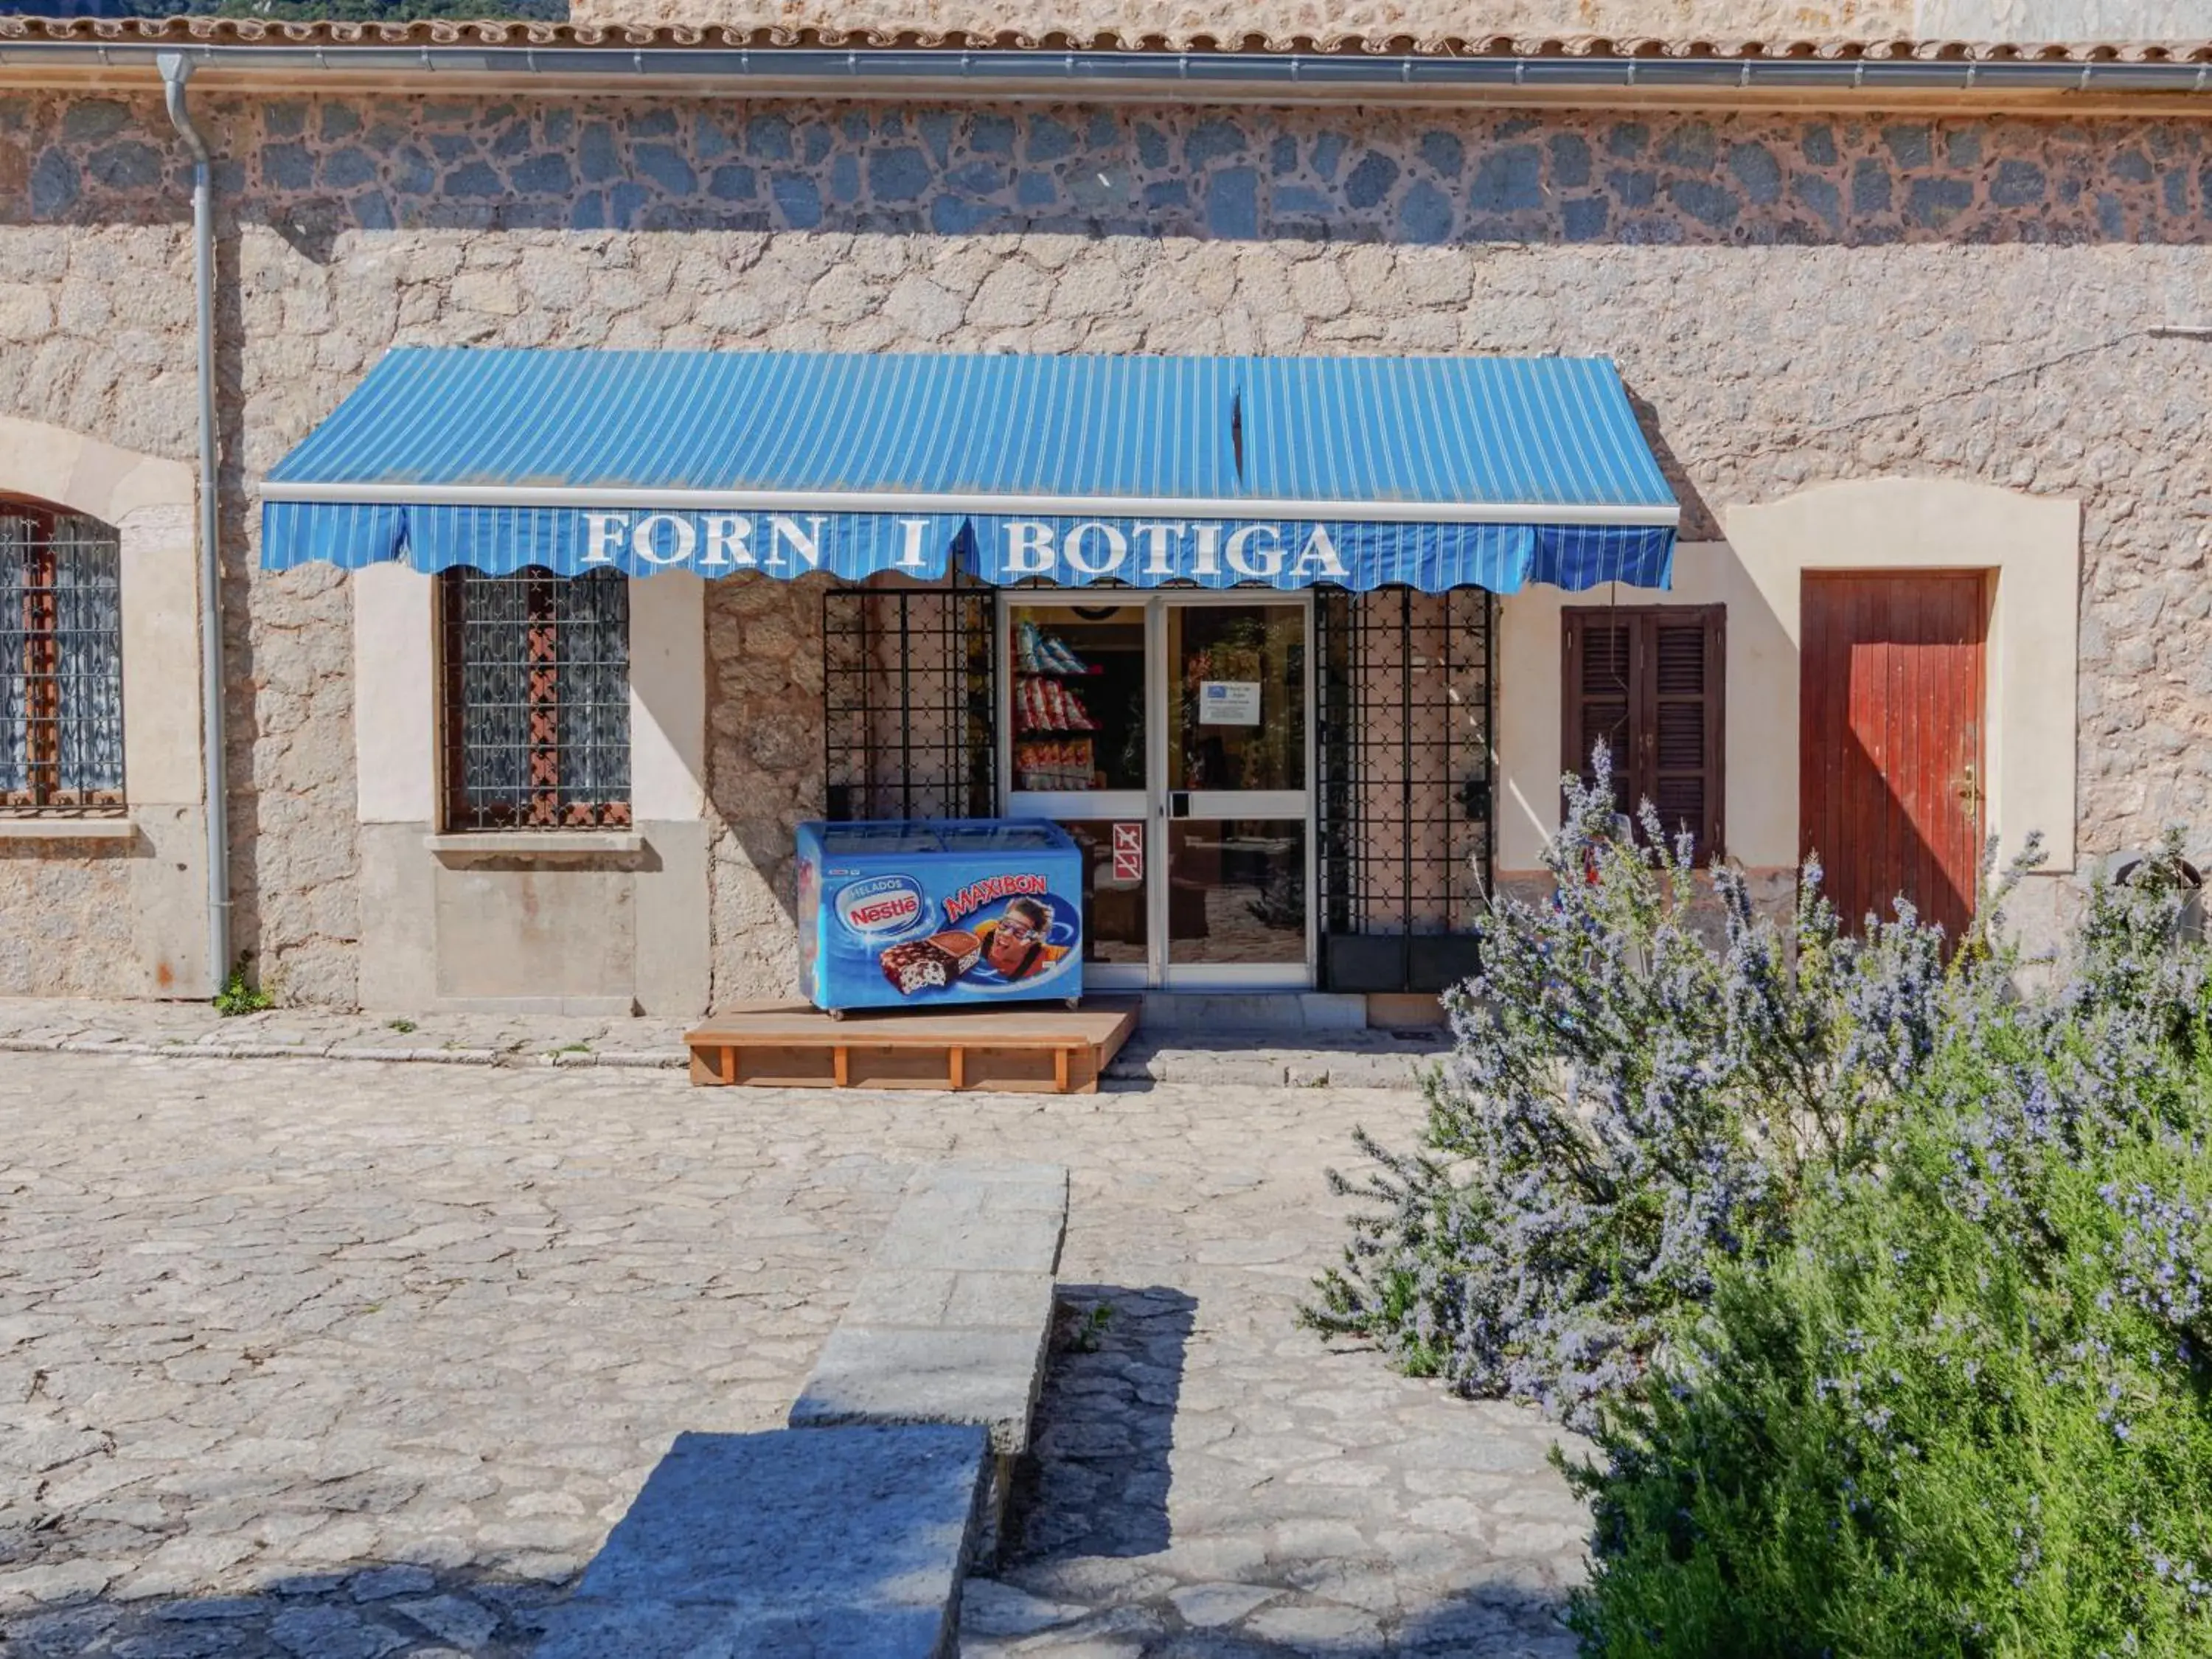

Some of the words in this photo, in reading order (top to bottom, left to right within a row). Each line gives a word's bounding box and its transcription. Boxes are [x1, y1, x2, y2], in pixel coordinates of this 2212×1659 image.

[580, 512, 828, 567] FORN
[894, 519, 930, 567] I
[1001, 522, 1350, 577] BOTIGA
[849, 878, 902, 899] HELADOS
[942, 874, 1047, 924] MAXIBON
[849, 895, 917, 927] Nestlé
